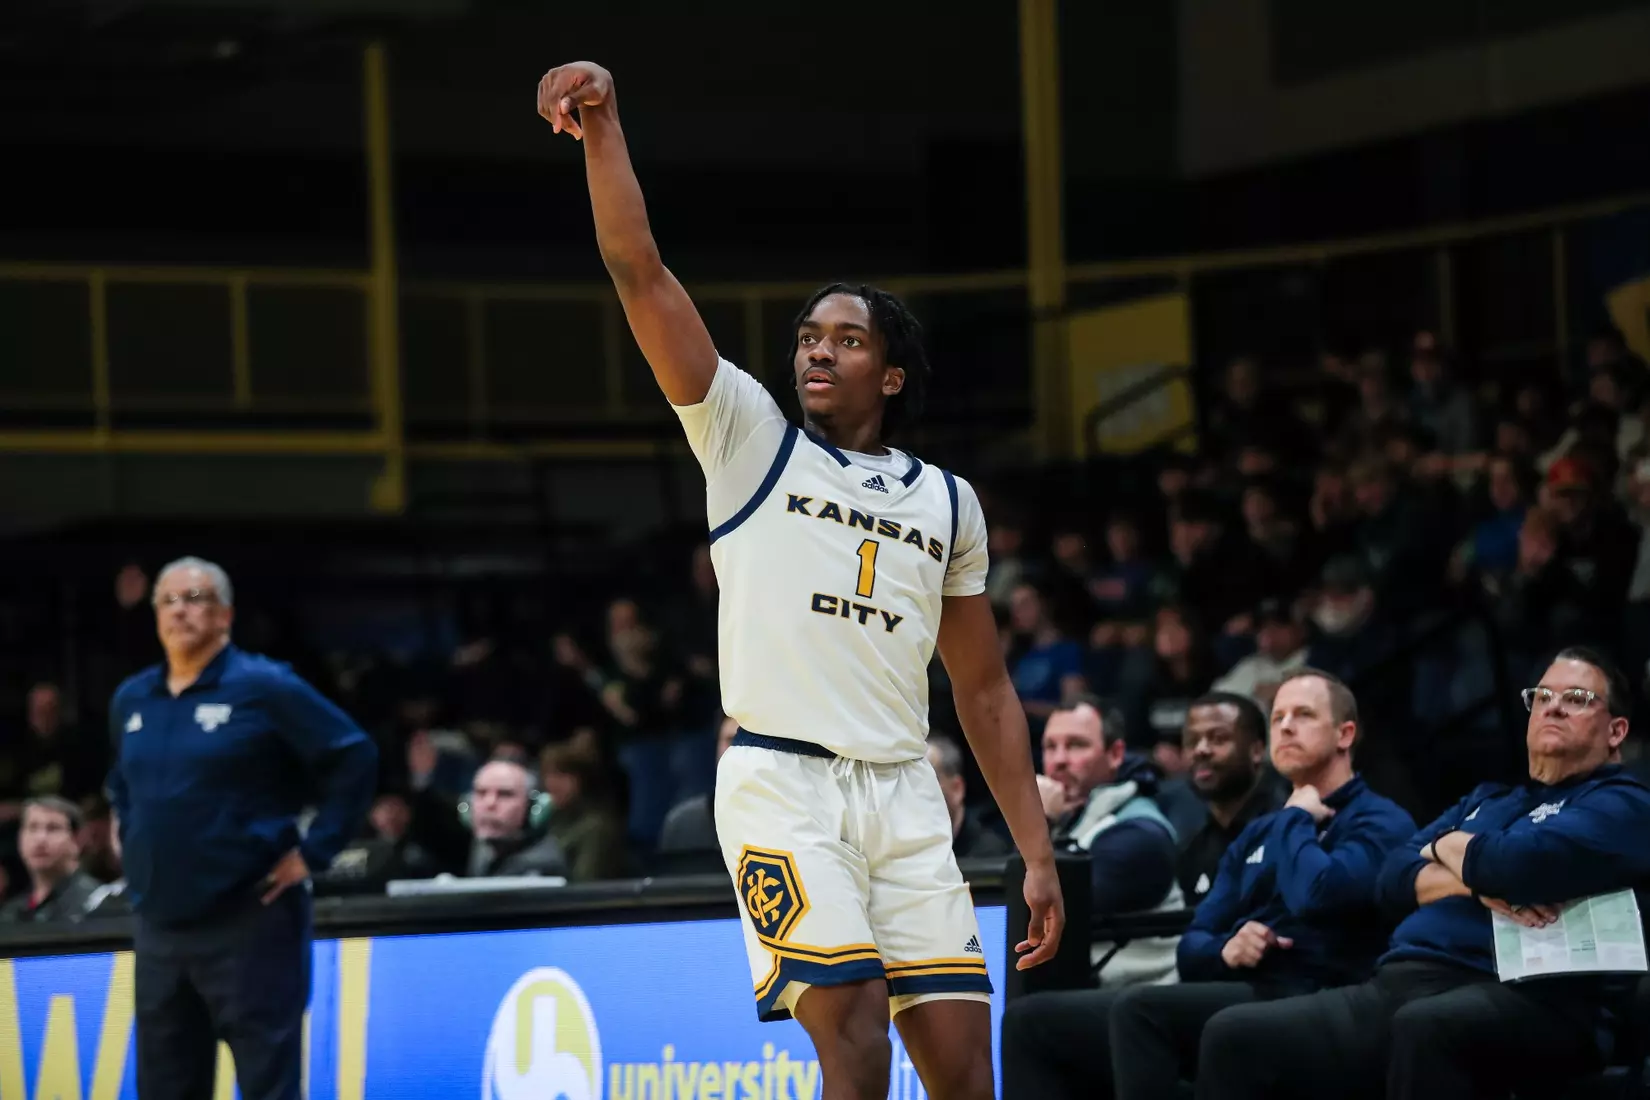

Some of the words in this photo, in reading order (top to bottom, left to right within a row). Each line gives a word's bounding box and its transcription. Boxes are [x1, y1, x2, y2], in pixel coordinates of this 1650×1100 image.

[861, 482, 889, 494] adidas
[786, 493, 944, 563] KANSAS
[856, 538, 879, 599] 1
[811, 593, 904, 633] CITY
[609, 1042, 819, 1100] university
